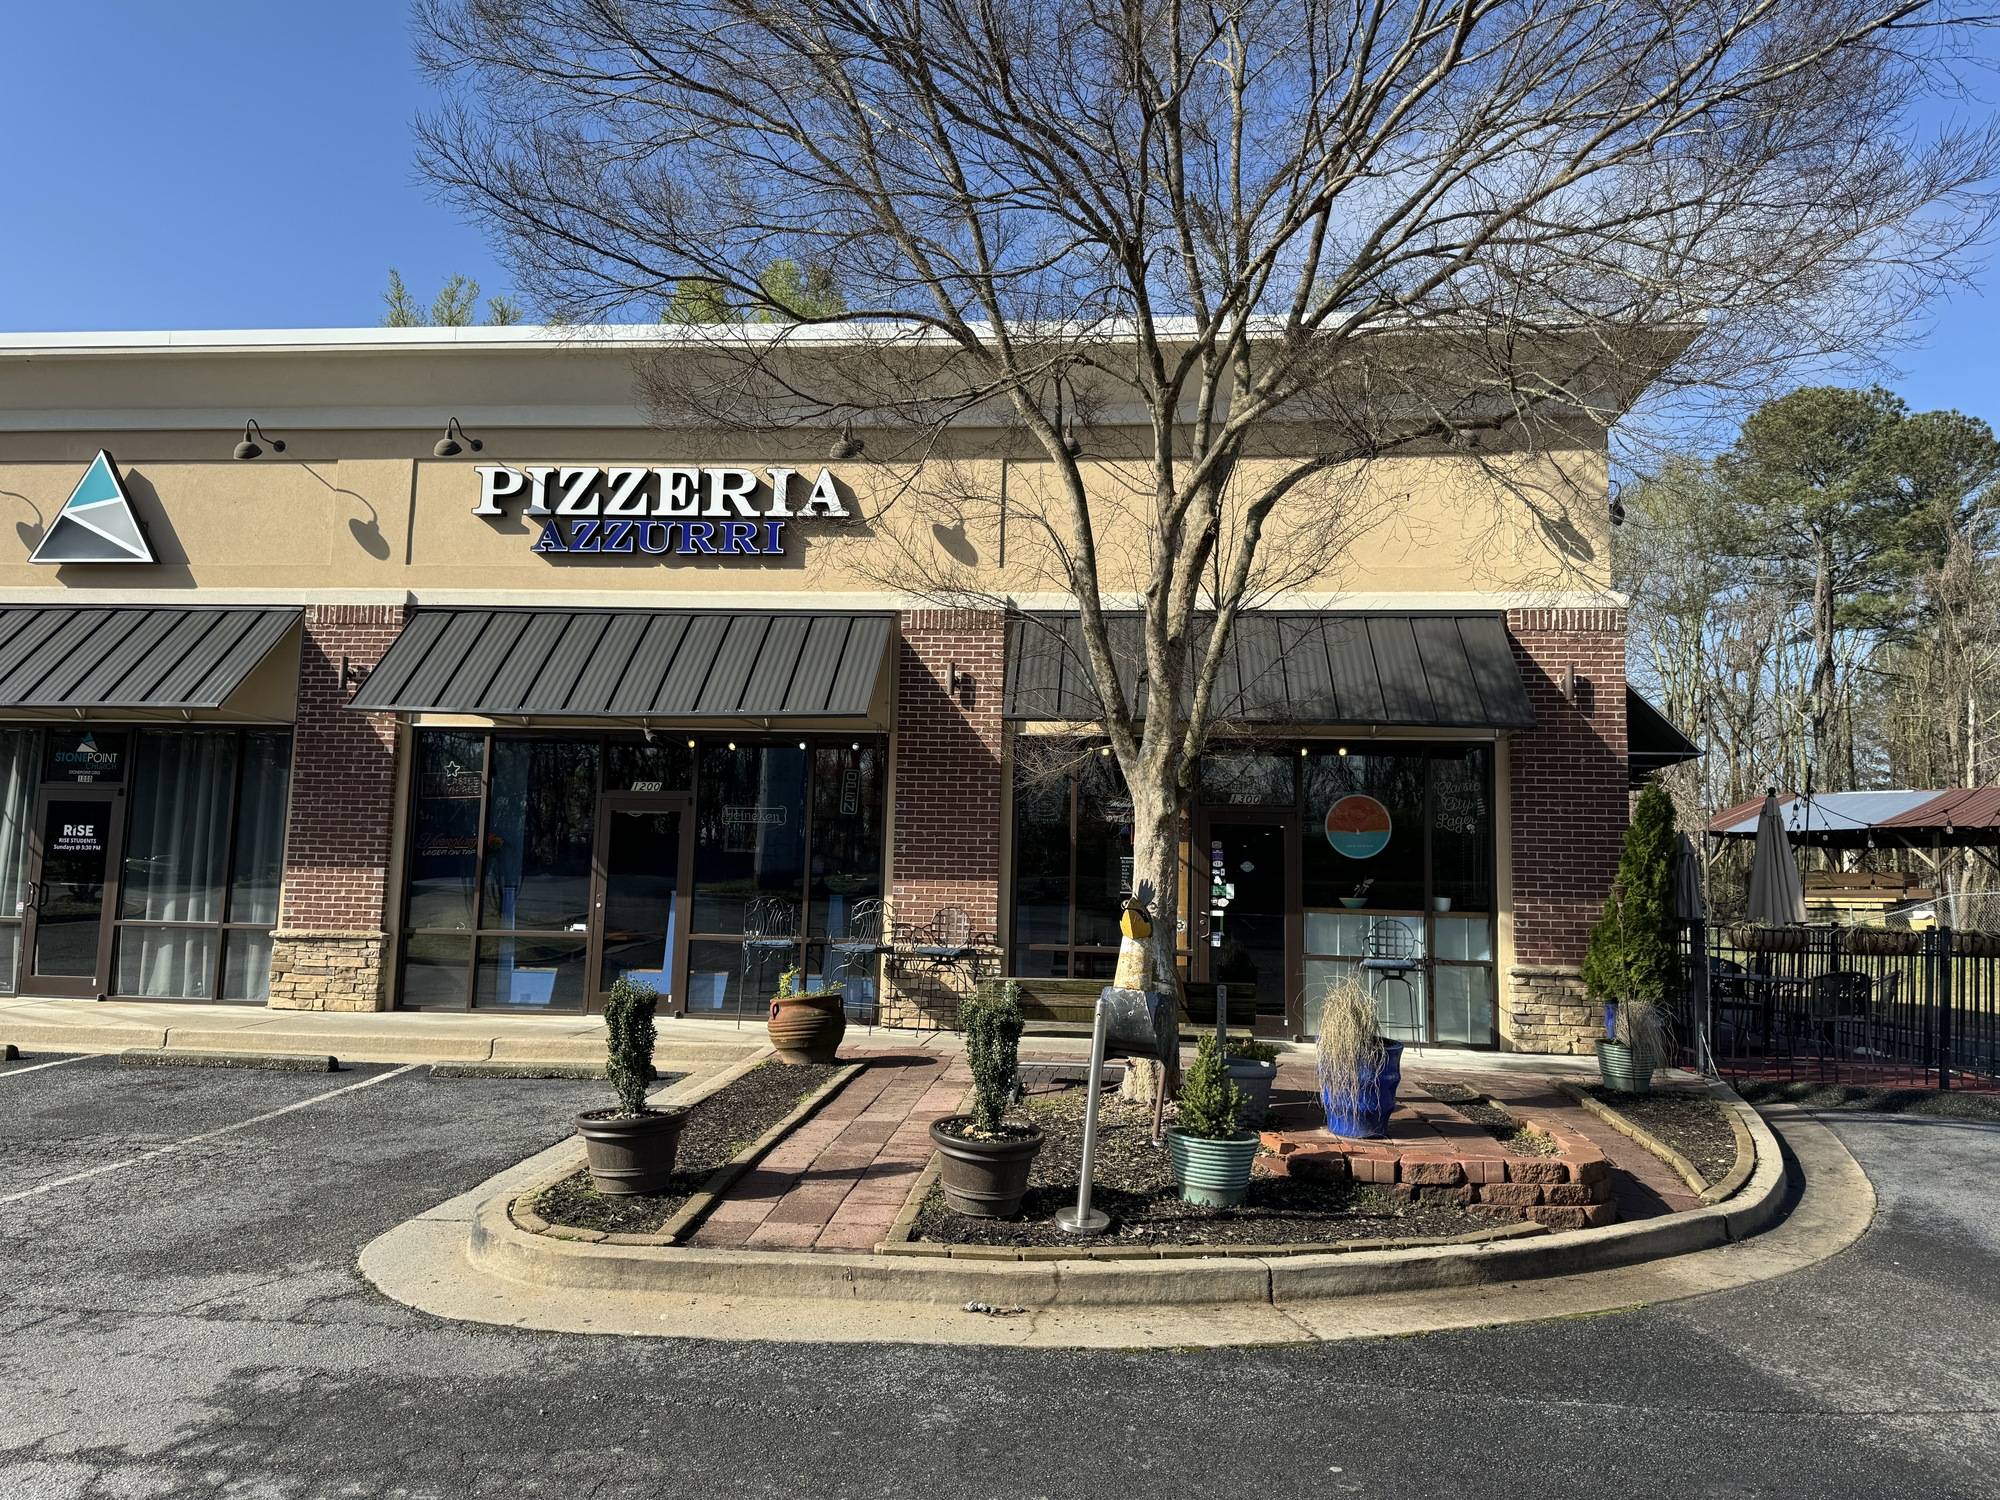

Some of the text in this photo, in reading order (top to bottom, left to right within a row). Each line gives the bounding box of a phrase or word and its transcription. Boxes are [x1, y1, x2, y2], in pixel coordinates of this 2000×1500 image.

[471, 465, 851, 517] PIZZERIA
[531, 519, 785, 554] AZZURRI
[55, 752, 119, 763] STONEPOINT
[633, 782, 661, 791] 1200
[1437, 781, 1481, 797] Classic
[1232, 795, 1260, 804] 1300
[1441, 797, 1474, 815] City
[725, 809, 783, 823] Heineken
[1435, 813, 1478, 834] Lager
